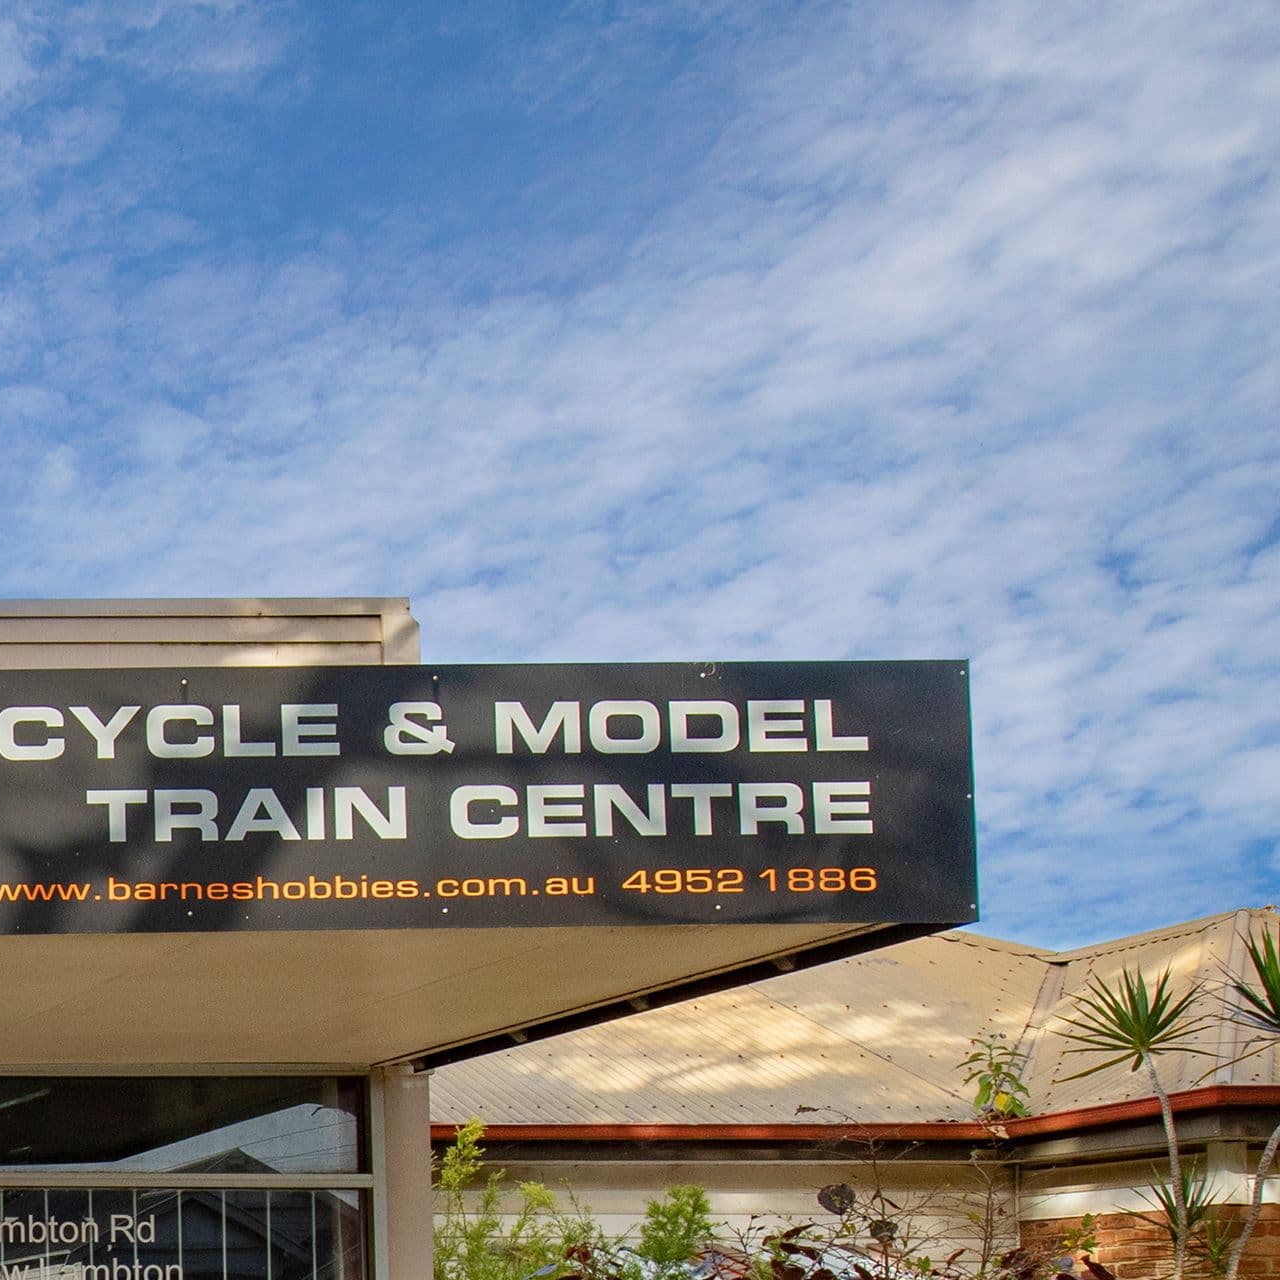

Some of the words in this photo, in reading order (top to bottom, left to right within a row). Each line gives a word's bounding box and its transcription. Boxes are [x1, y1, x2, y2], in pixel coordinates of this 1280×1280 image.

[383, 702, 456, 756] &
[495, 699, 870, 754] MODEL
[86, 786, 407, 842] TRAIN
[449, 781, 874, 840] CENTRE
[621, 867, 745, 895] 4952
[759, 866, 878, 893] 1886
[110, 1214, 156, 1243] Rd
